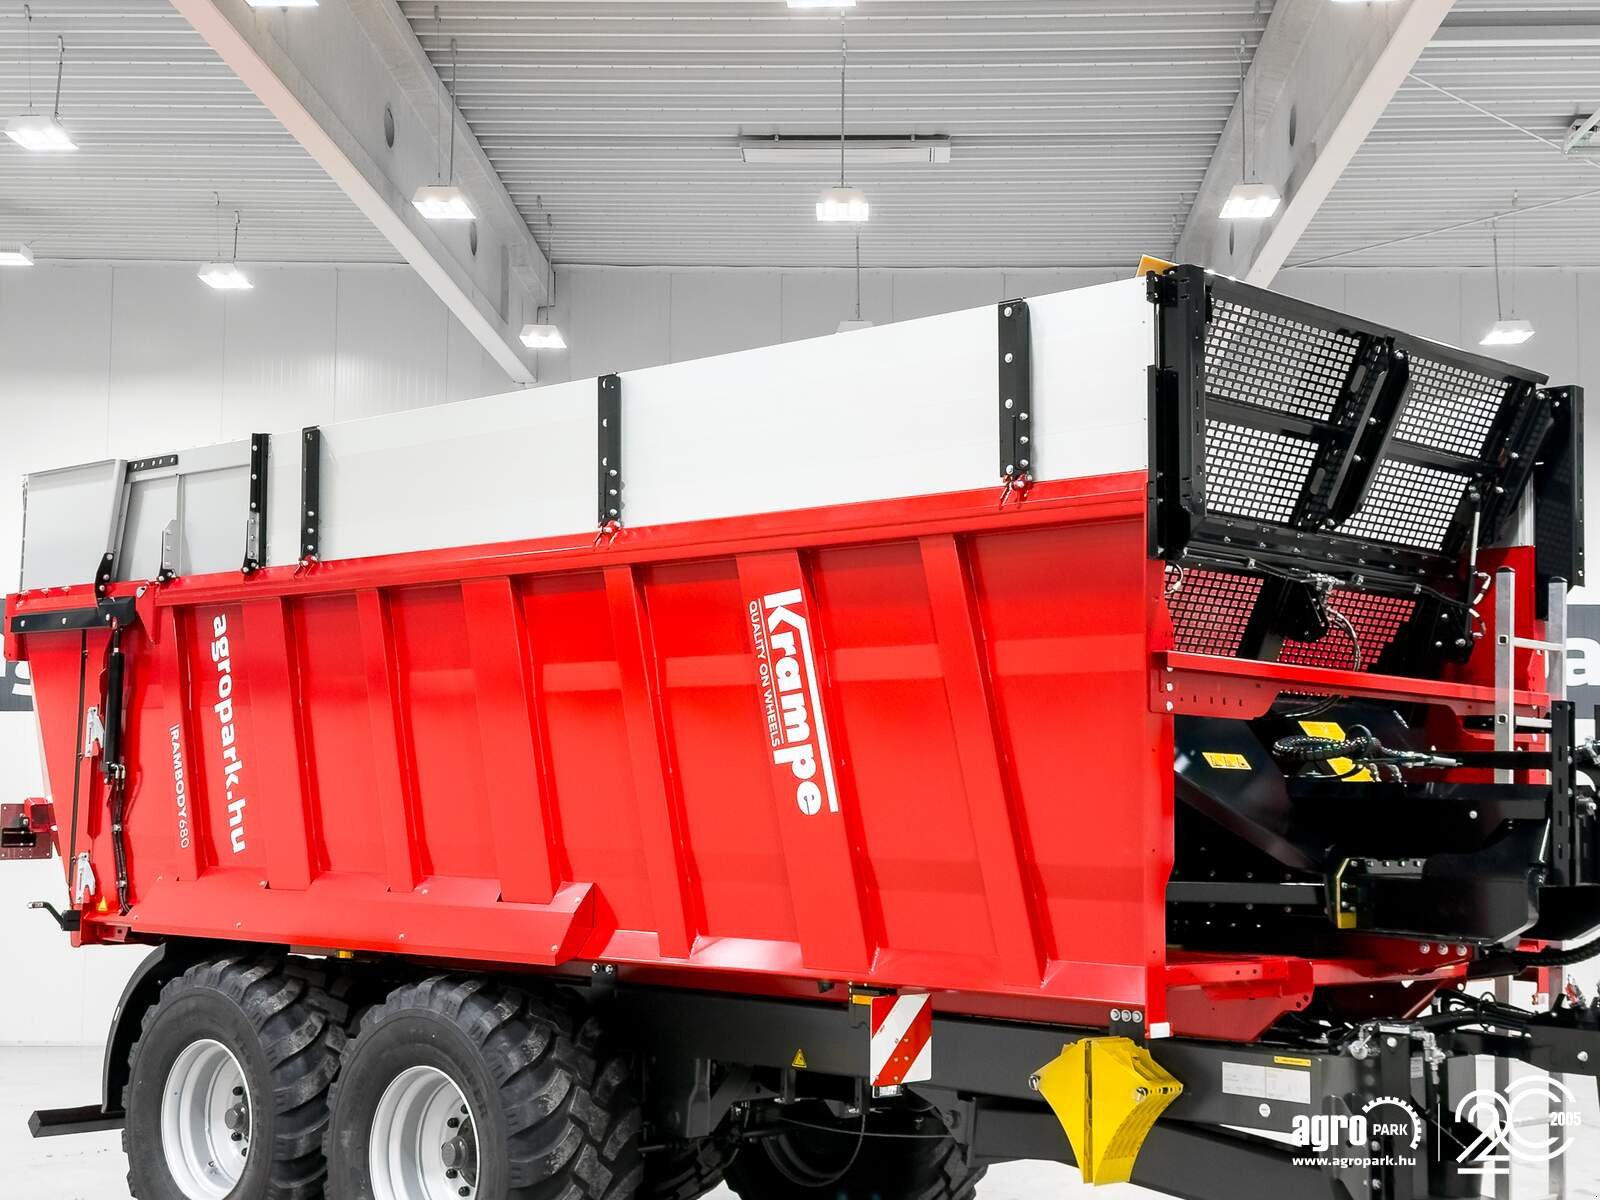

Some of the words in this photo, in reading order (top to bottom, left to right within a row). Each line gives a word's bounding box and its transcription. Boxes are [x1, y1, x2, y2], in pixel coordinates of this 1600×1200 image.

[748, 599, 767, 660] QUALITY
[759, 664, 771, 688] ON
[763, 588, 839, 816] Krampe
[211, 613, 246, 854] agropark.hu
[763, 689, 782, 747] WHEELS
